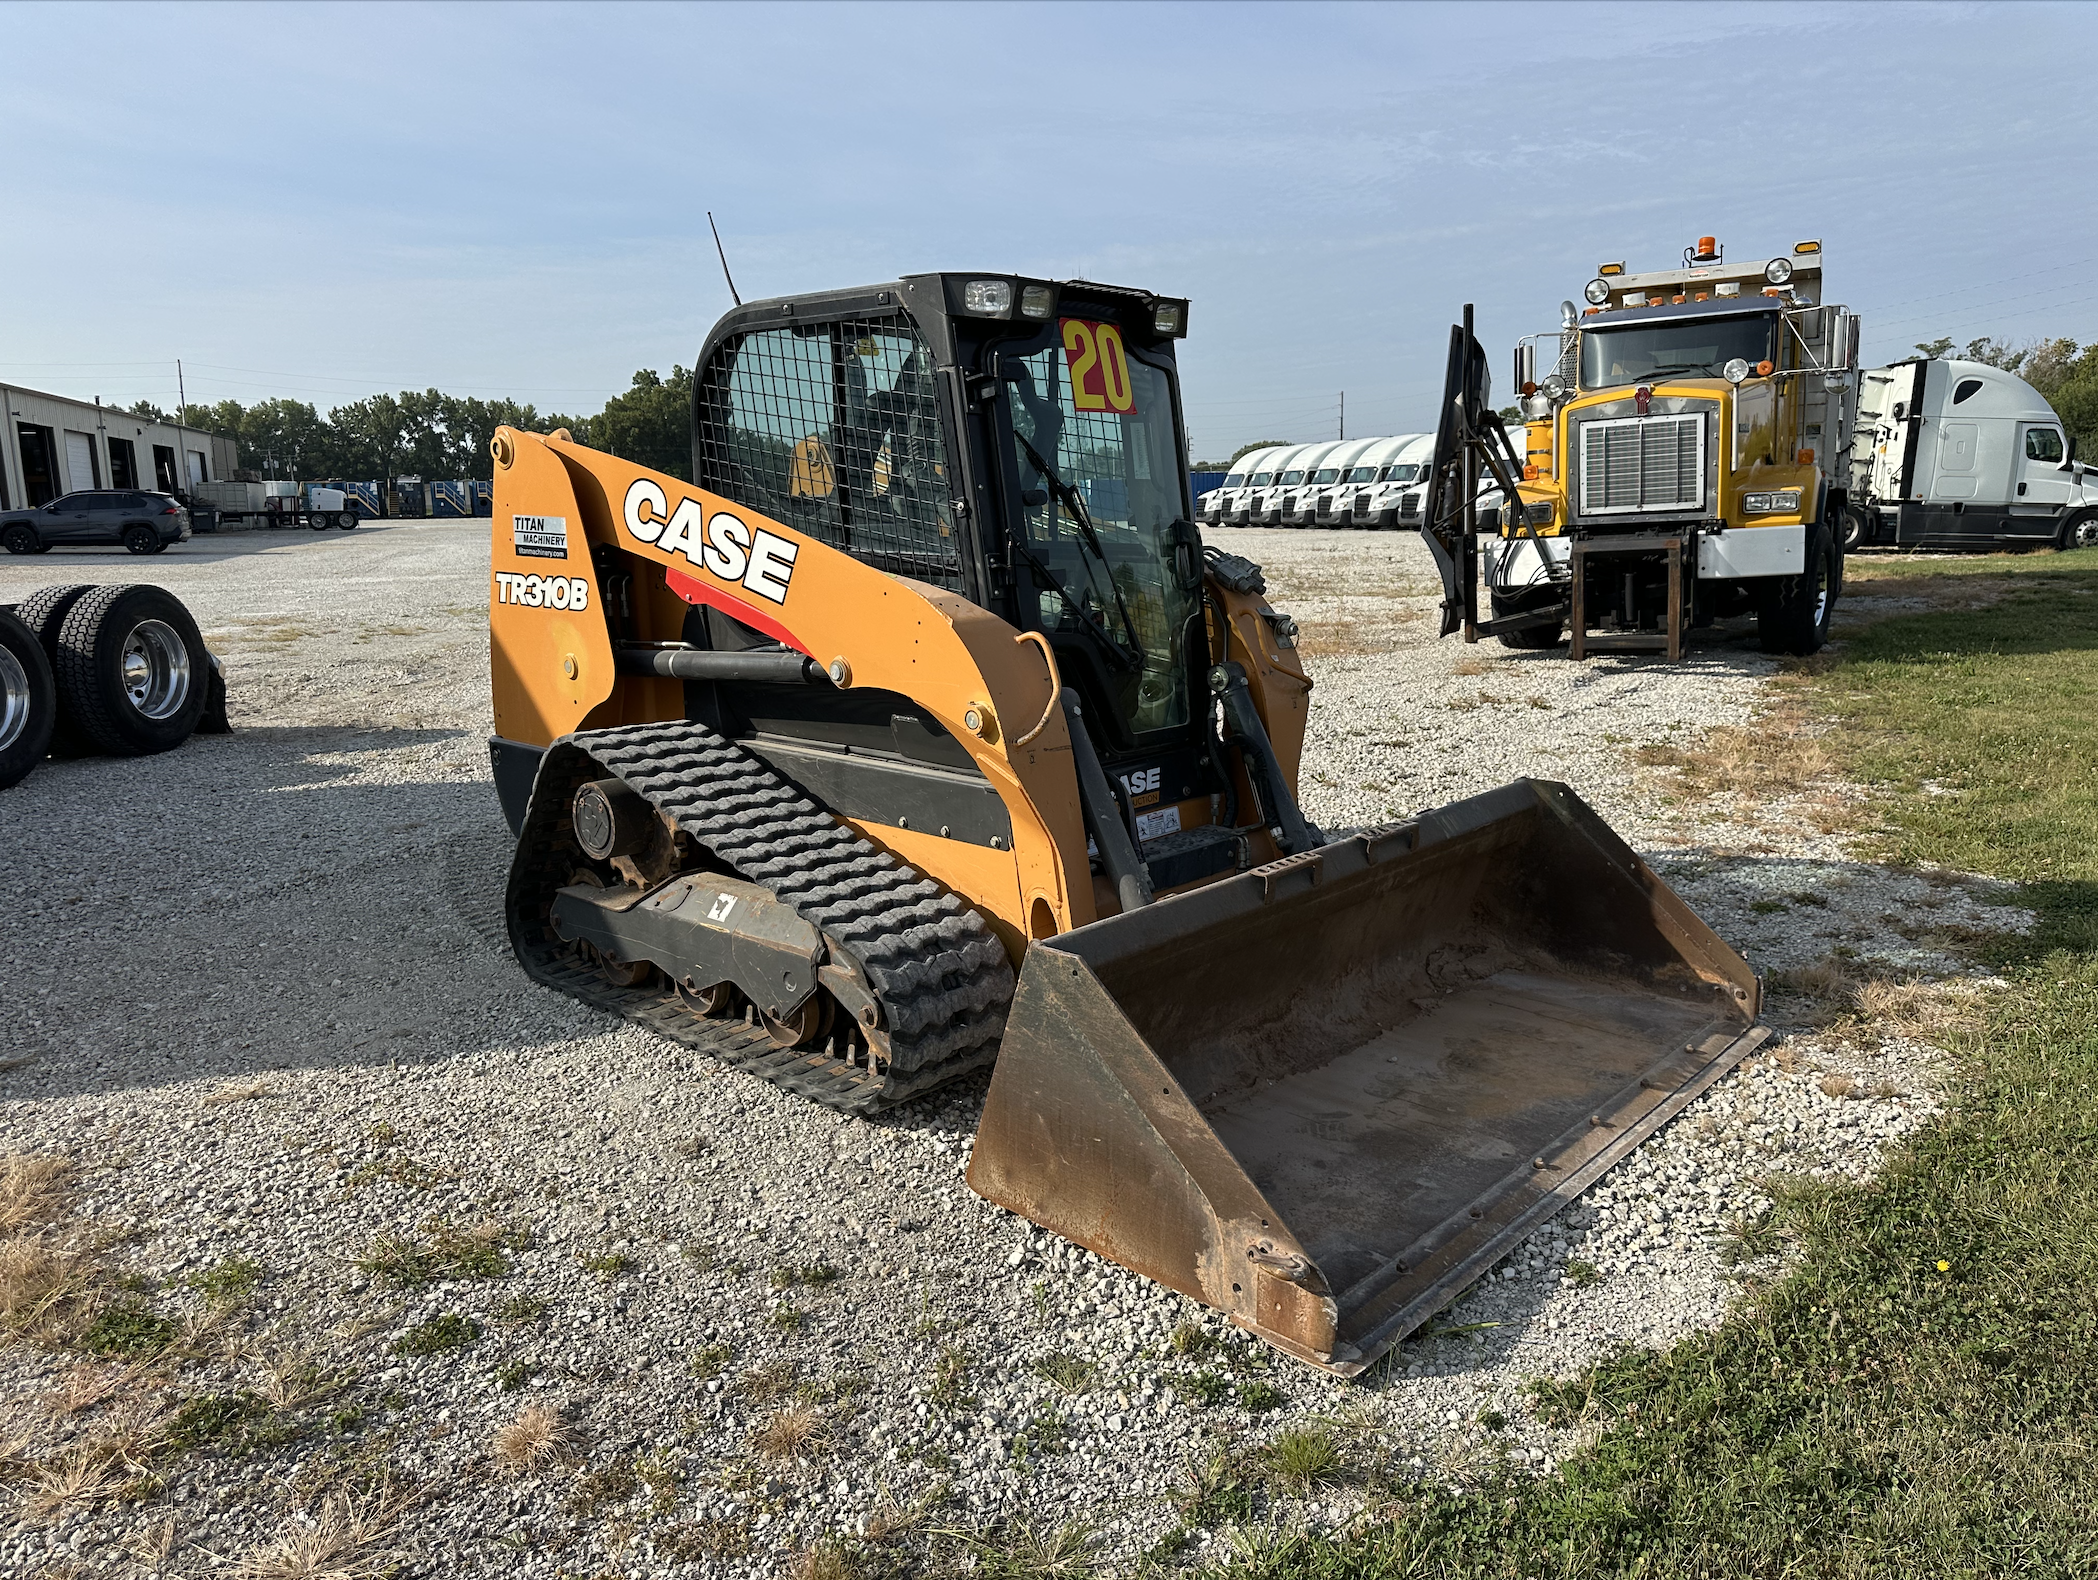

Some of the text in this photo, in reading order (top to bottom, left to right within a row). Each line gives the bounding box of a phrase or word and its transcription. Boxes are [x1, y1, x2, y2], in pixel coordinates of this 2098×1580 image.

[1063, 320, 1132, 410] 20
[515, 517, 544, 531] TITAN
[523, 534, 565, 545] MACHINERY
[623, 477, 799, 606] CASE
[518, 547, 564, 558] titanmachinery.com
[495, 571, 588, 611] TR310B
[1119, 766, 1161, 795] ASE
[1133, 793, 1158, 806] UCTION
